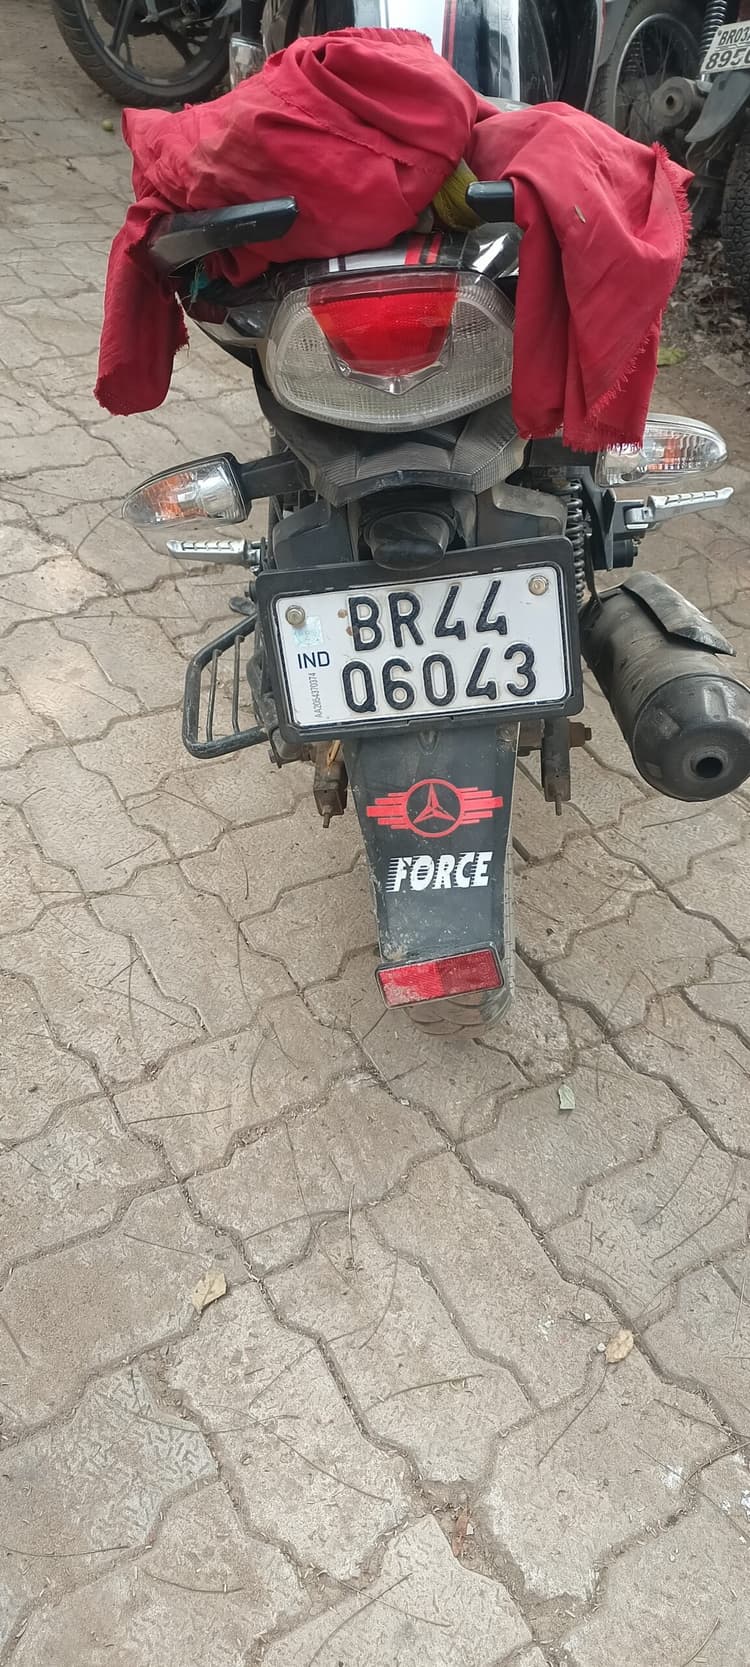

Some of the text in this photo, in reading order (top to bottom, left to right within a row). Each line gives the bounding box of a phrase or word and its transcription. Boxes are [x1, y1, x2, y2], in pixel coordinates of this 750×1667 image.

[348, 580, 508, 651] BR44
[297, 651, 330, 669] IND
[342, 643, 537, 713] Q6043
[385, 851, 493, 893] FORCE
